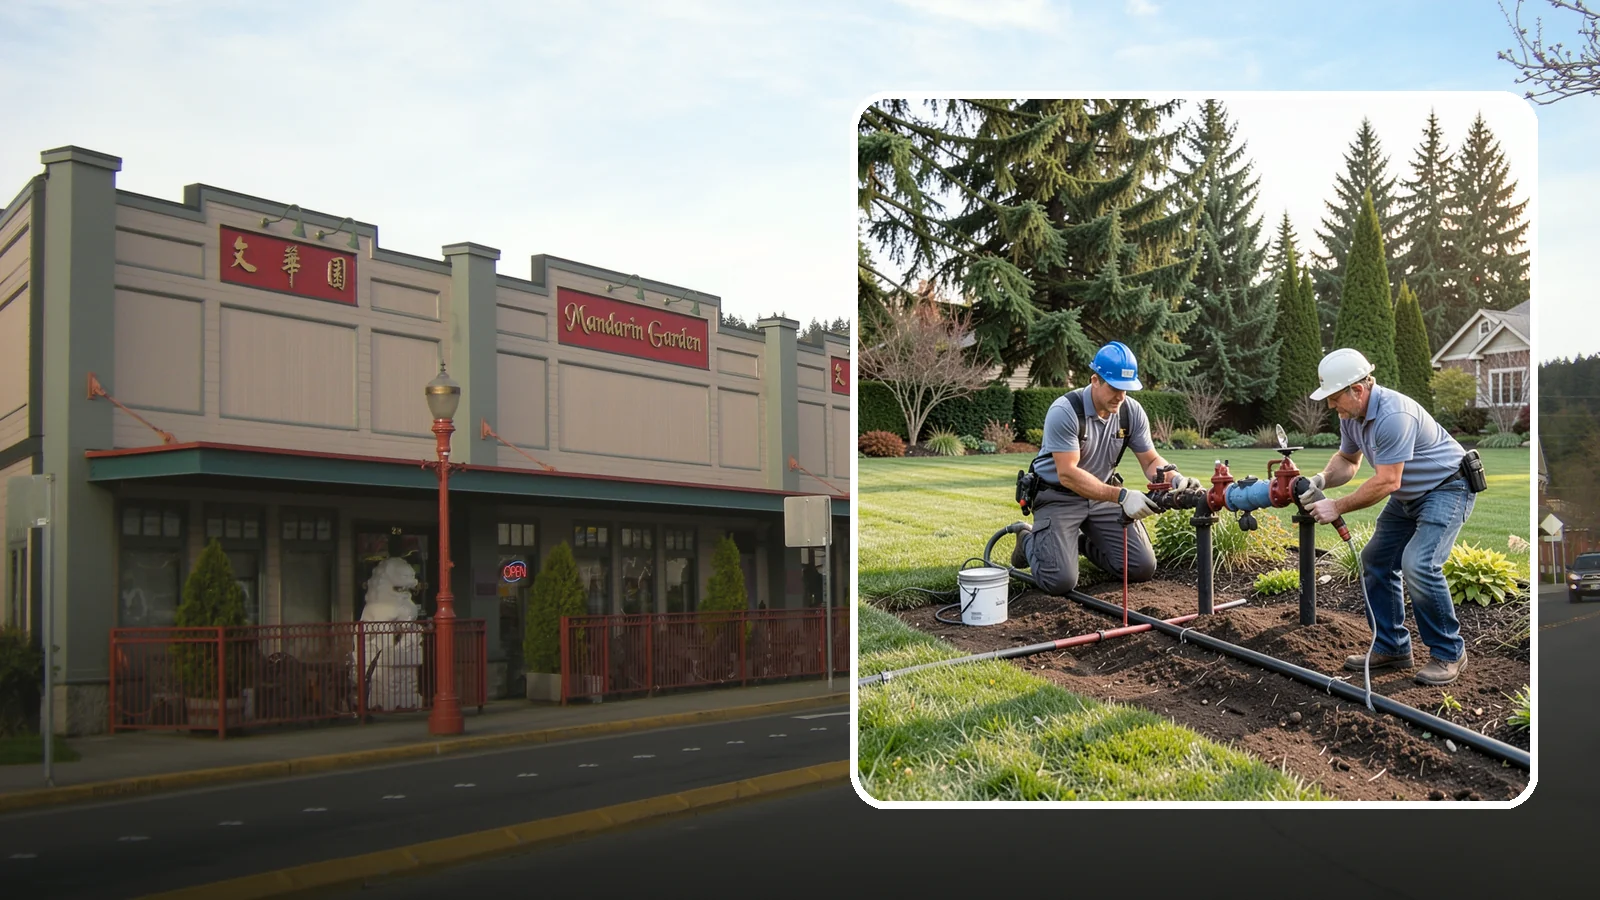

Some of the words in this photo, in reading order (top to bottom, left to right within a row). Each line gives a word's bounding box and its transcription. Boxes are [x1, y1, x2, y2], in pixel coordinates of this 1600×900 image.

[564, 302, 644, 342] Mandarin
[647, 320, 702, 352] Garden
[503, 565, 527, 578] OPEN
